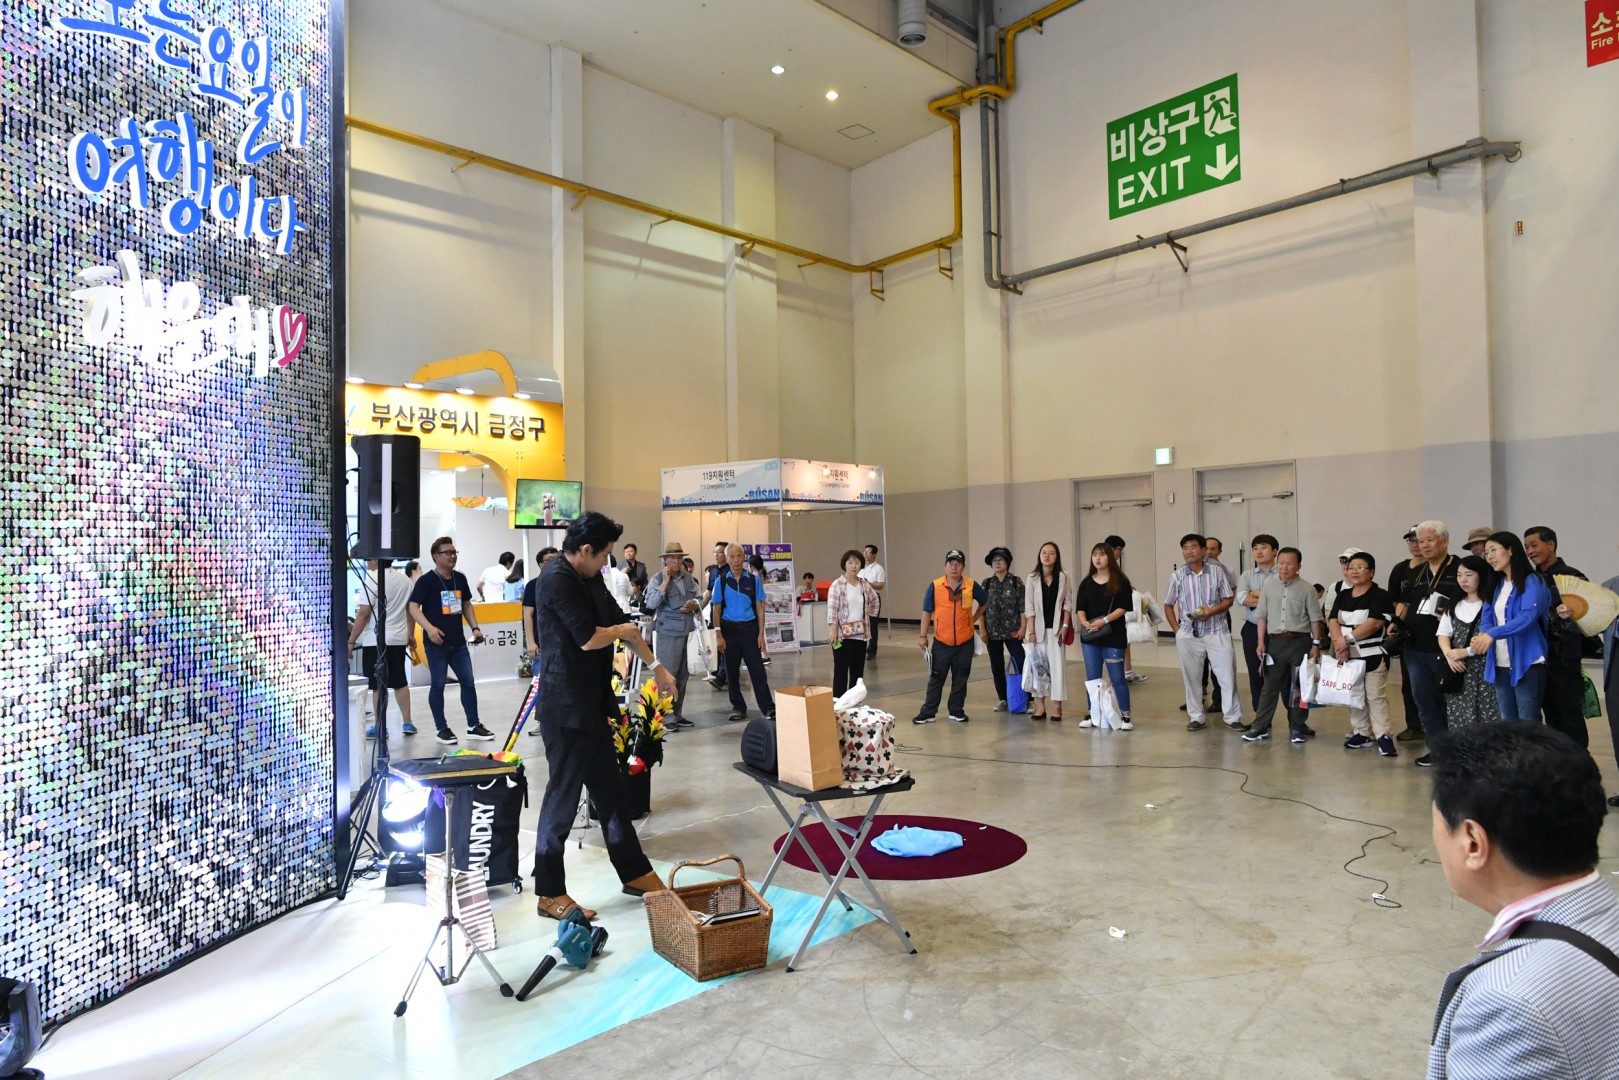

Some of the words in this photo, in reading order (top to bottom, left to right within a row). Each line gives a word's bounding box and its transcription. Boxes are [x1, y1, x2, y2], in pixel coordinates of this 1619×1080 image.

[1591, 37, 1614, 50] Fire
[1110, 101, 1200, 163] 비상구
[69, 112, 307, 255] 여행이다
[1117, 155, 1191, 209] EXIT
[371, 403, 479, 436] 부산광역시
[488, 413, 545, 442] 금정구
[702, 469, 735, 481] 119지원센터
[497, 630, 517, 646] 금정
